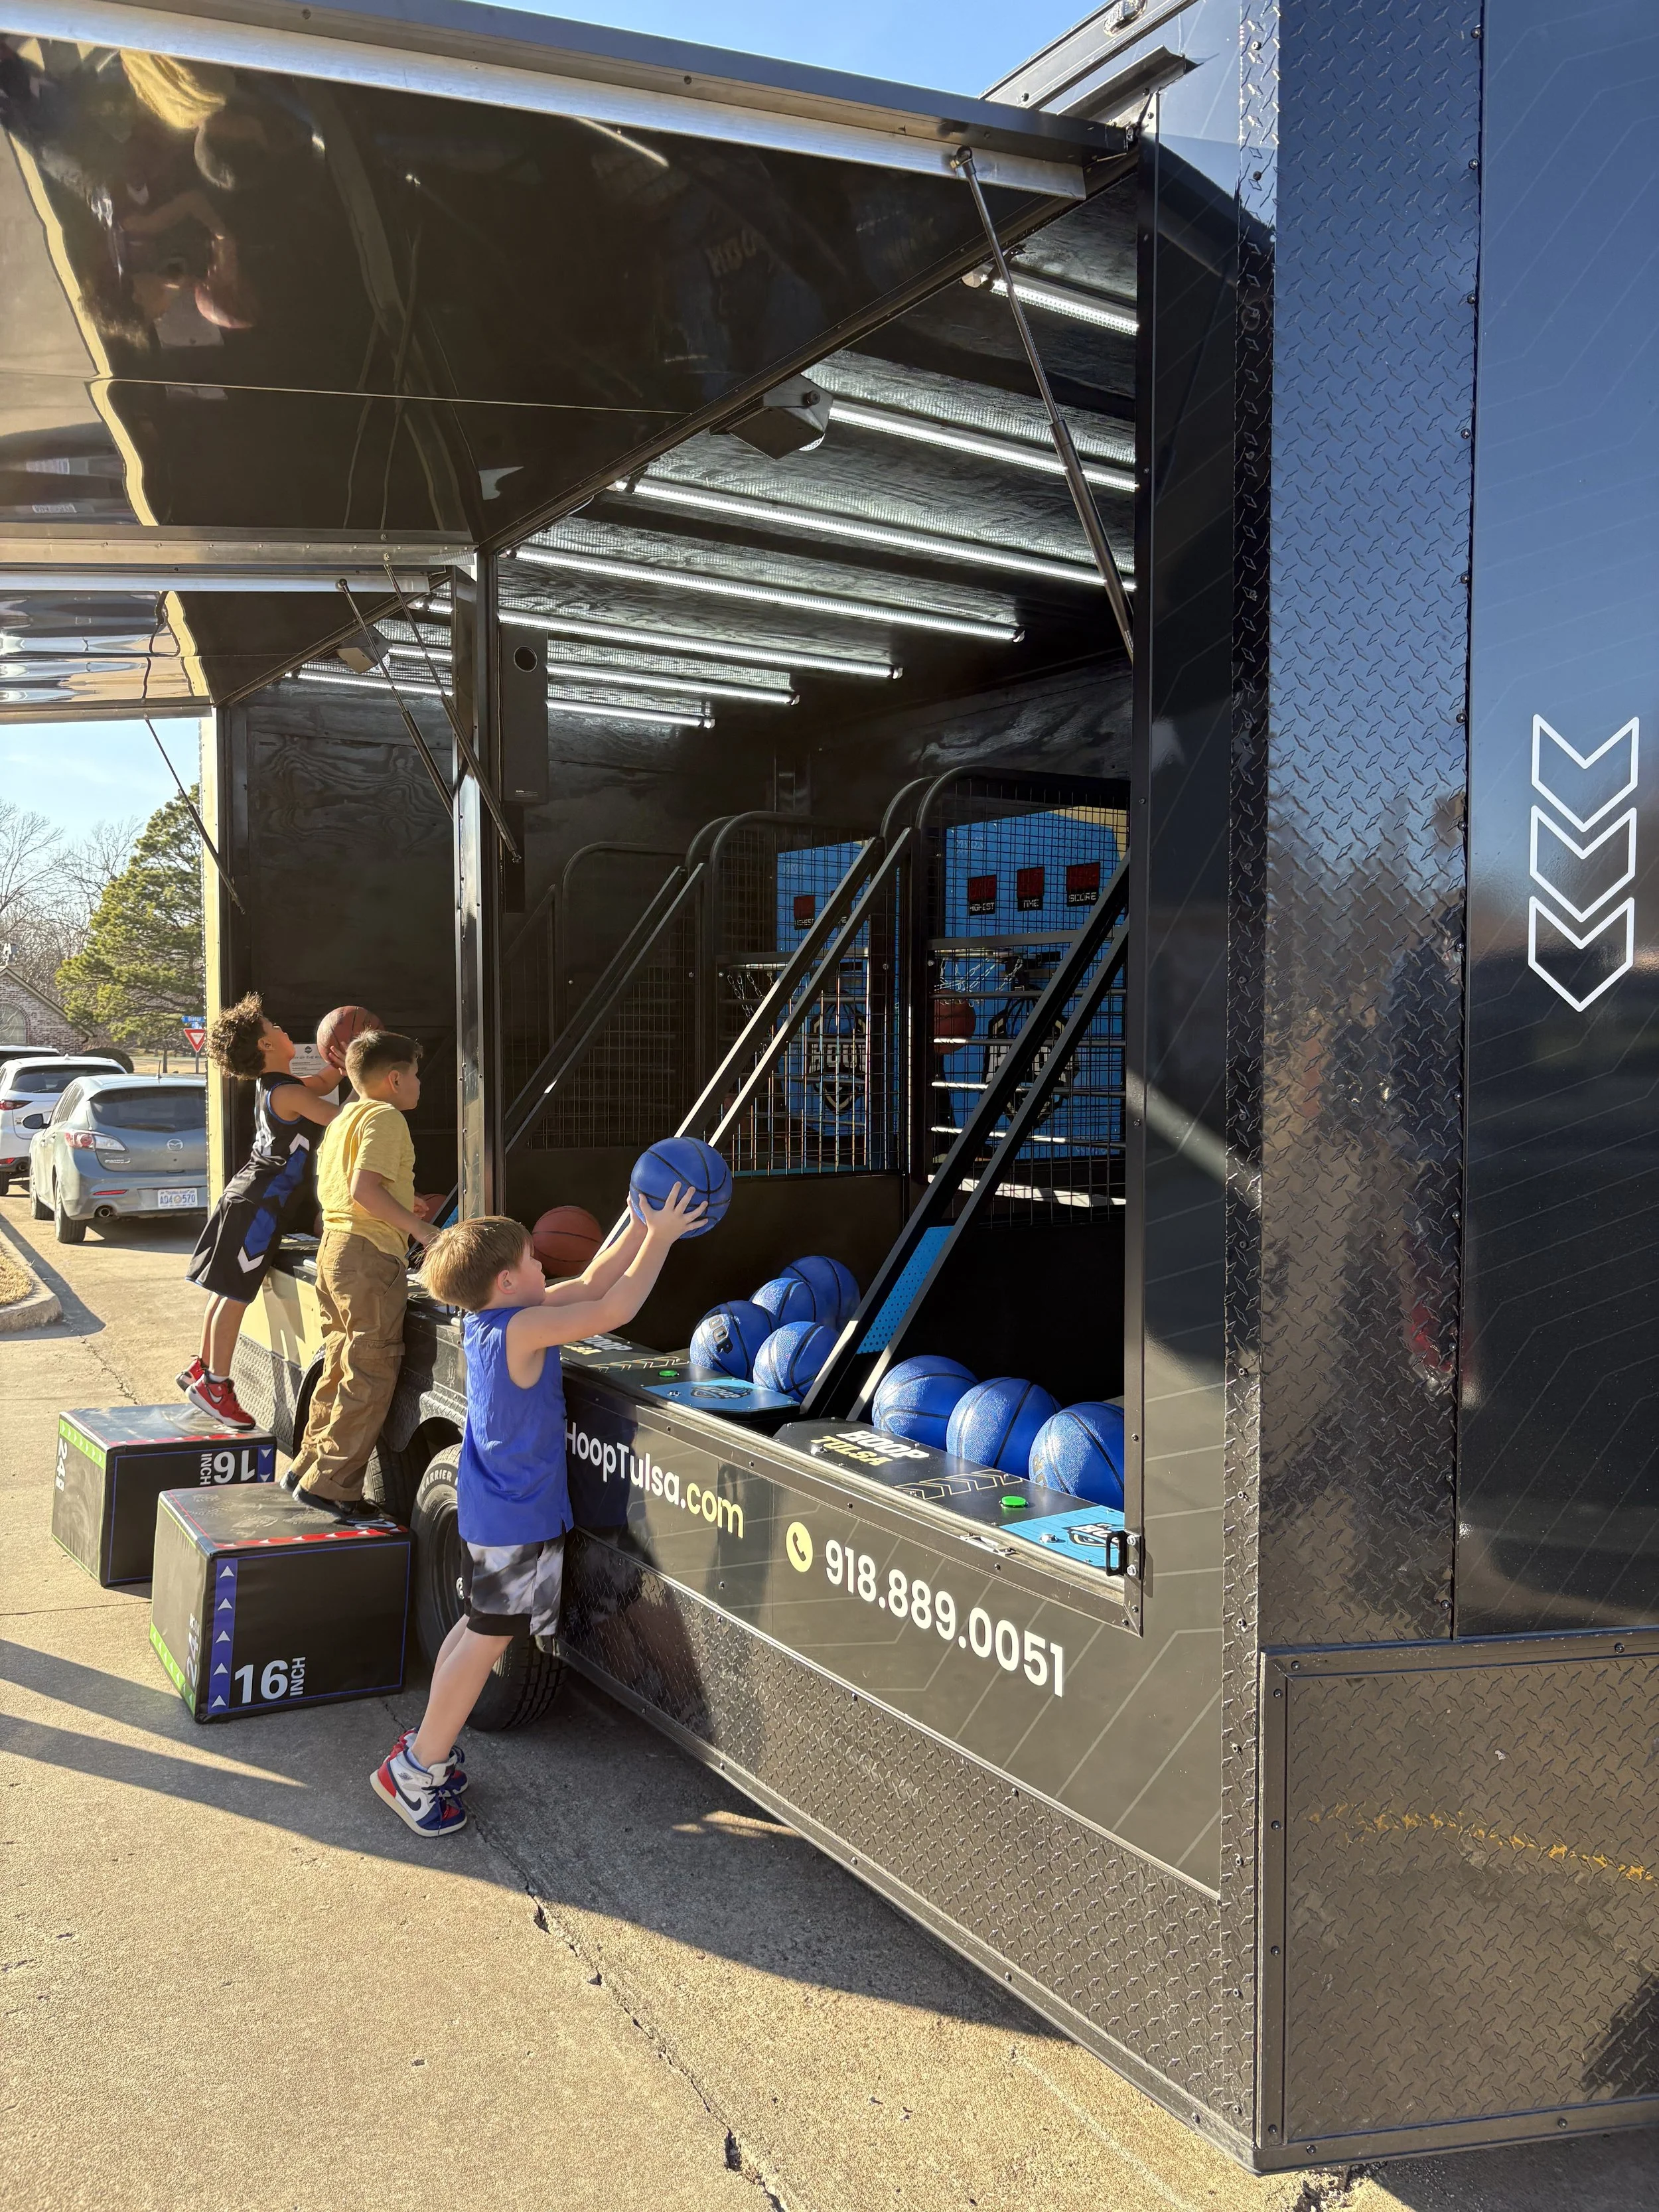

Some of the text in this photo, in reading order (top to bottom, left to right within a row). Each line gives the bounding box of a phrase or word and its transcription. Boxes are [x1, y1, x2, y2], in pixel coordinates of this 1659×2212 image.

[1023, 899, 1039, 909] TIME
[56, 1438, 68, 1477] 24
[810, 1435, 894, 1466] TULSA
[835, 1430, 930, 1459] HOOP
[199, 1449, 255, 1486] 16 INCH
[565, 1422, 744, 1539] HoopTulsa.com
[825, 1539, 1064, 1698] 918.889.0051
[186, 1631, 199, 1689] 24
[234, 1657, 306, 1704] 16 INCH
